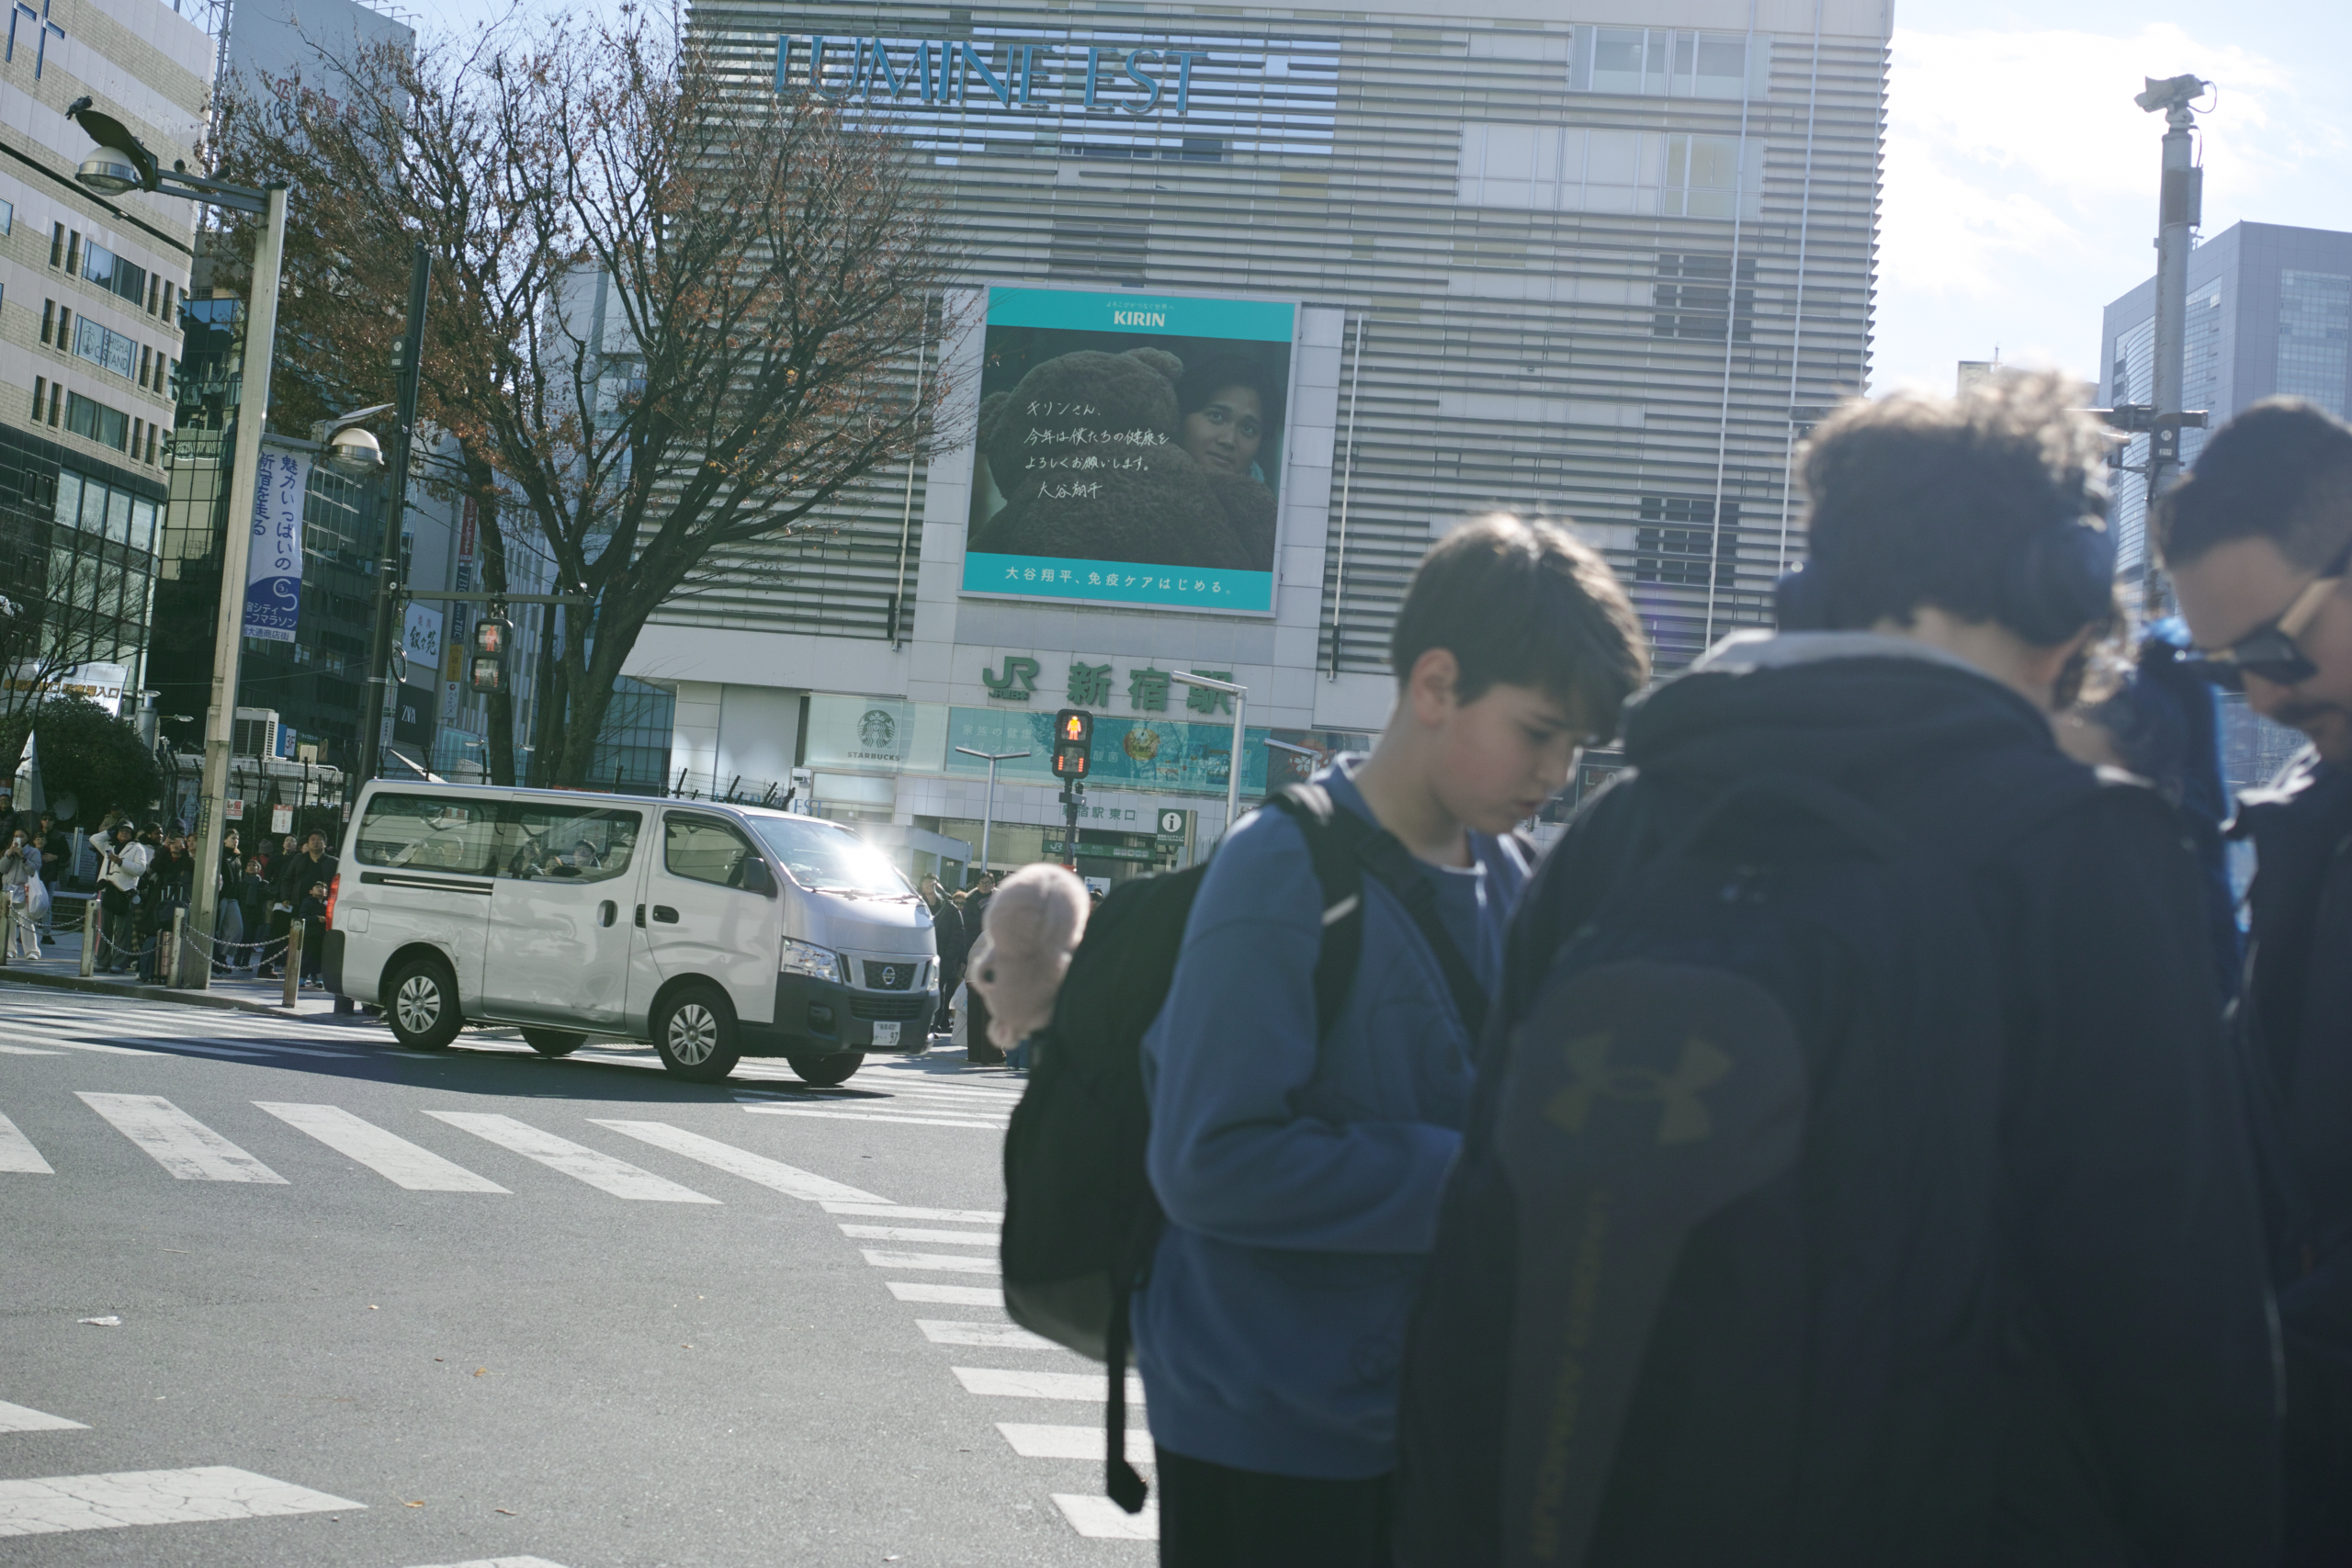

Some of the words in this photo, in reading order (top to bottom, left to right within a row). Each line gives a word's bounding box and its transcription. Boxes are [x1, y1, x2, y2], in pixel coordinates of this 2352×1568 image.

[775, 35, 1053, 109] LUMINE
[1082, 46, 1210, 115] EST
[1106, 301, 1175, 310] よろこびがつなぐ世界へ
[1114, 310, 1166, 327] KIRIN
[104, 334, 129, 355] SHISHA
[1027, 400, 1101, 416] キリンさん、
[1023, 428, 1170, 446] 今年は僕たちの健康を
[1025, 456, 1148, 471] よろしくお願いします。
[1037, 480, 1102, 499] 大谷翔平
[1005, 566, 1231, 595] 大谷翔平、免疫ケアはじめる。
[982, 656, 1039, 690] JR
[1066, 661, 1233, 715] 新宿駅
[847, 751, 900, 761] STARBUCKS
[794, 798, 828, 818] EST
